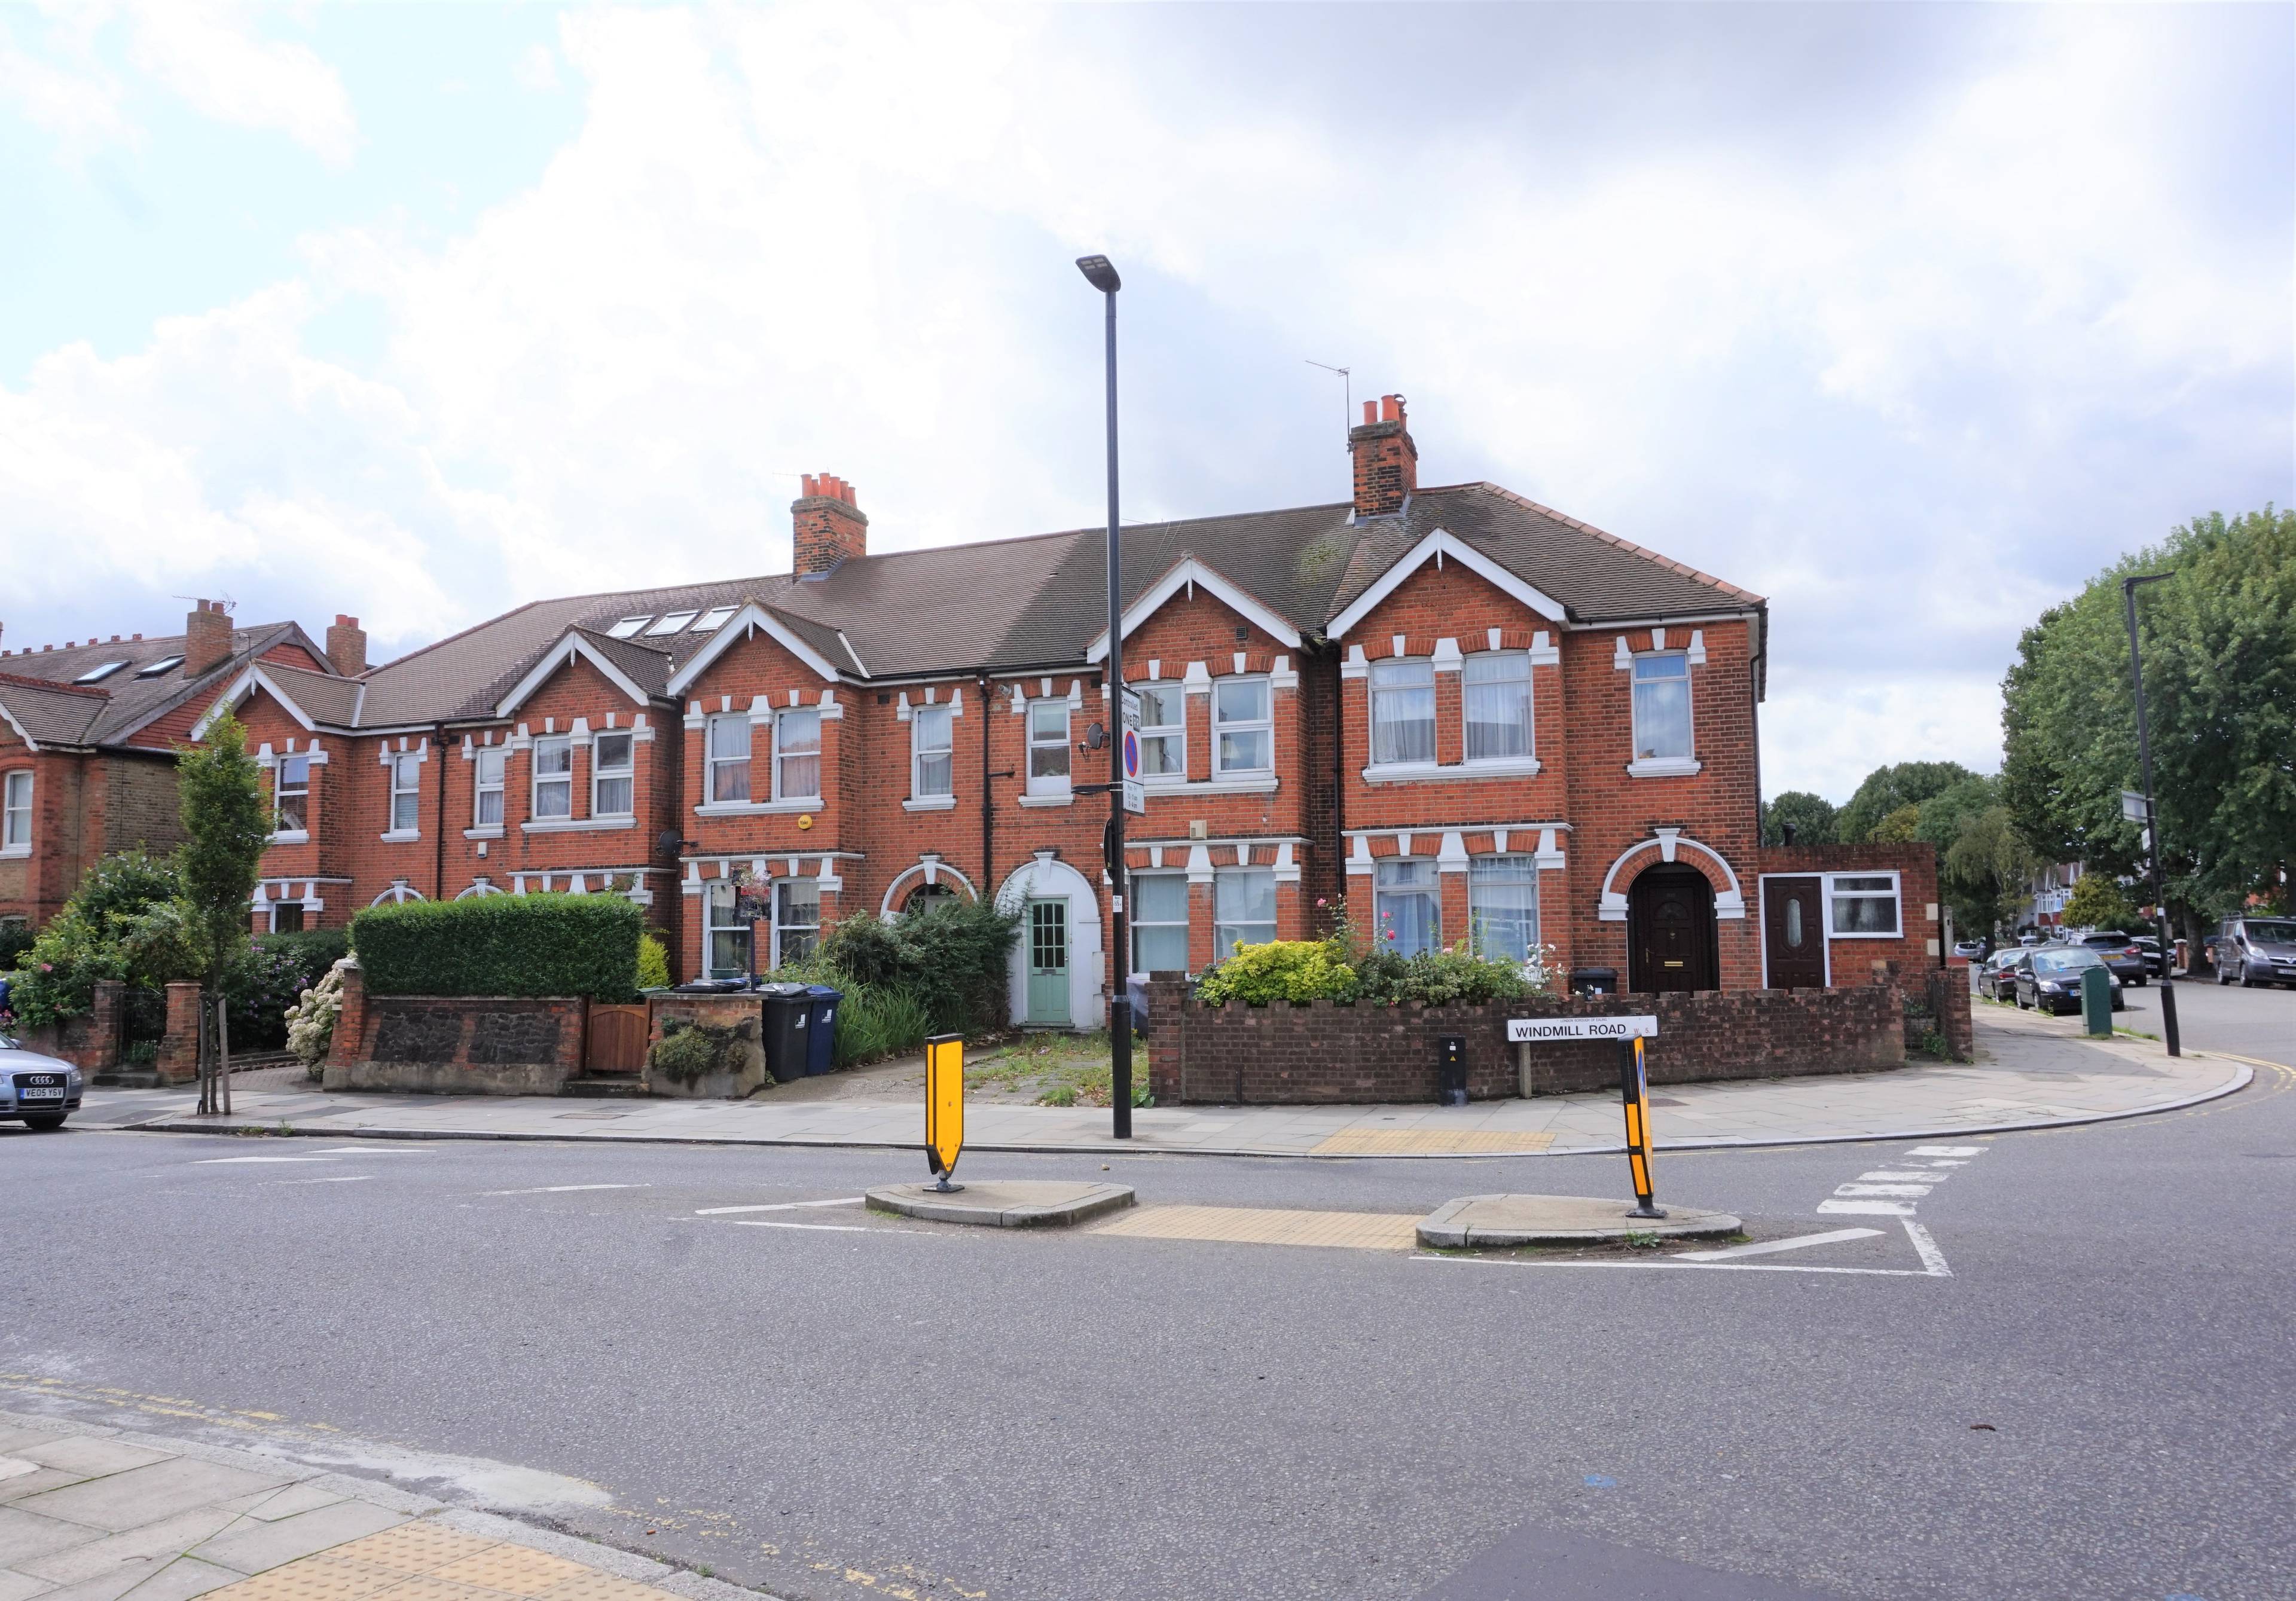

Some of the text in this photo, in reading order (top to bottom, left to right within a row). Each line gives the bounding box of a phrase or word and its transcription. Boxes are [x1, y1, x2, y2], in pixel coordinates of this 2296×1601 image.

[1122, 712, 1132, 726] ONE
[1516, 1025, 1583, 1038] WINDMILL
[1589, 1024, 1626, 1035] ROAD
[26, 1089, 46, 1097] VE05
